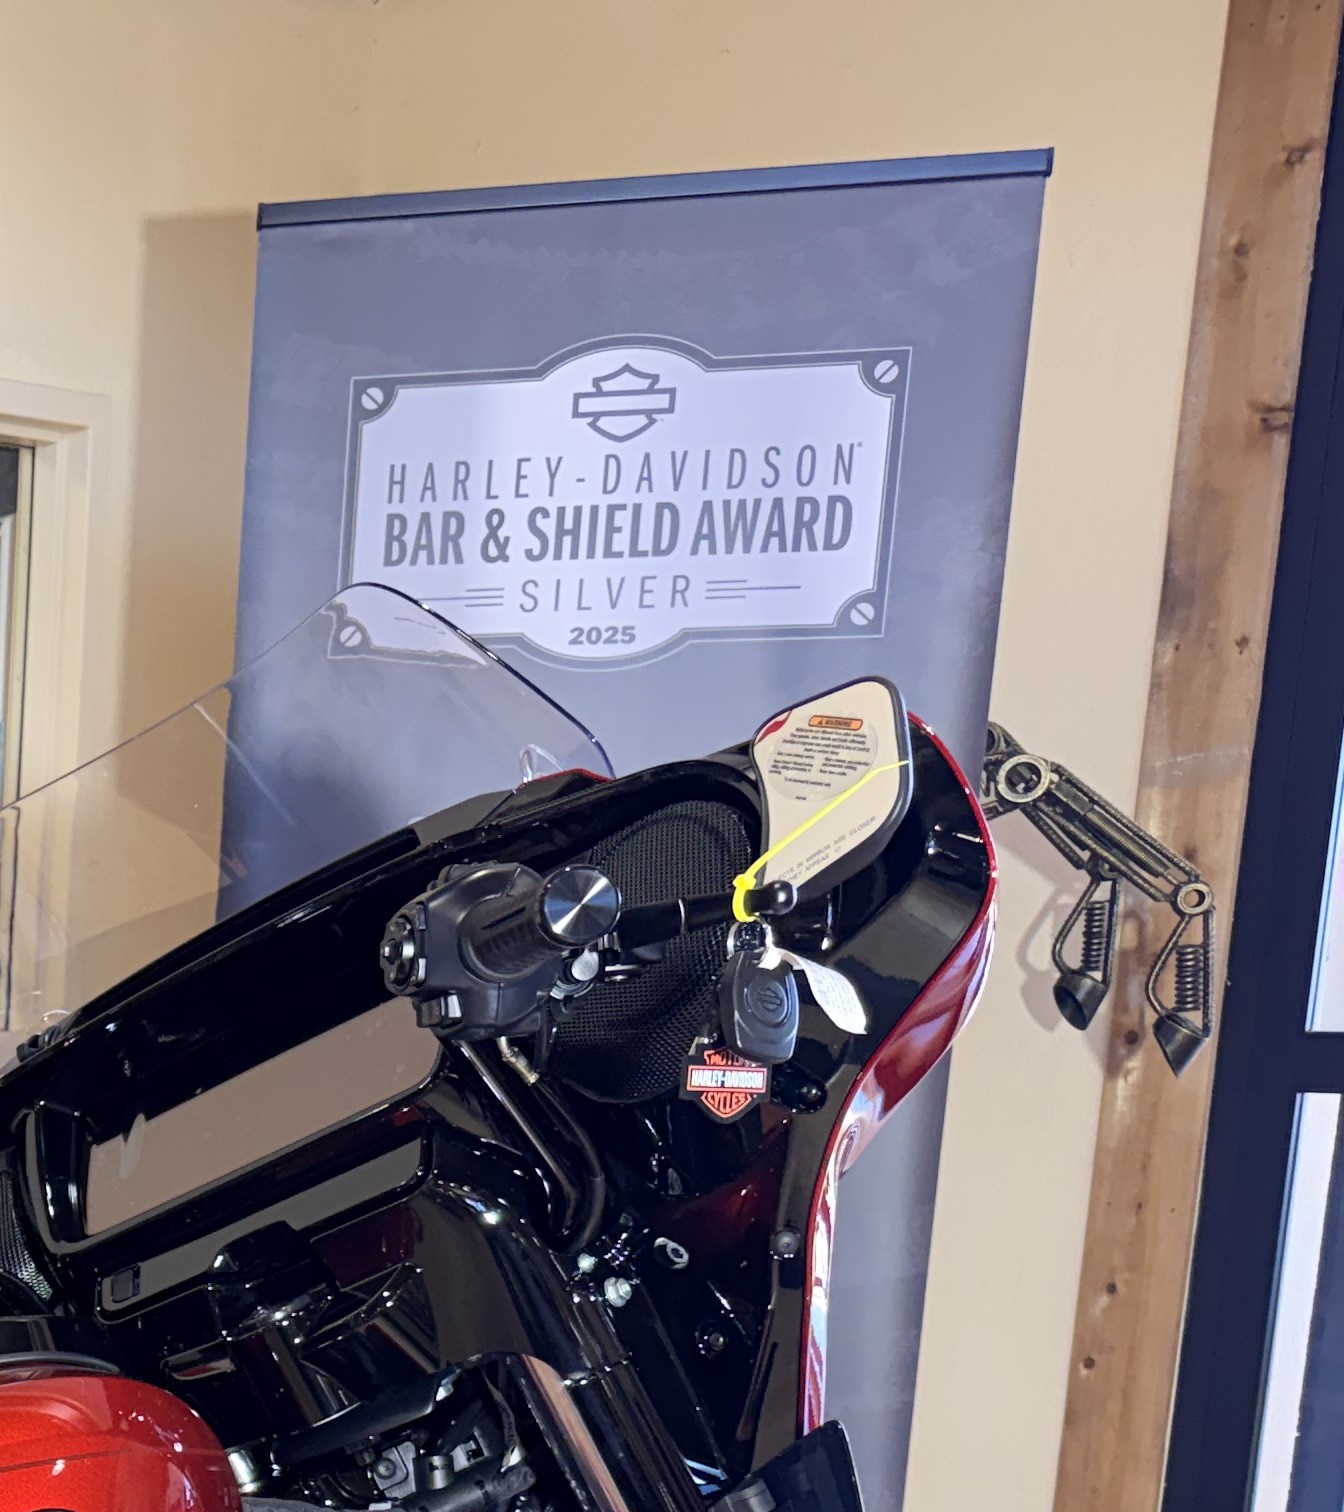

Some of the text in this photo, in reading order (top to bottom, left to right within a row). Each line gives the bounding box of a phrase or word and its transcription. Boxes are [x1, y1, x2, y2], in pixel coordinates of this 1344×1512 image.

[387, 443, 855, 504] HARLEY-DAVIDSON
[383, 494, 854, 567] BAR & SHIELD AWARD
[518, 574, 691, 613] SILVER
[567, 625, 637, 646] 2025
[690, 1069, 765, 1089] HARLEY-DAVIDSON
[707, 1092, 746, 1114] CYCLES
